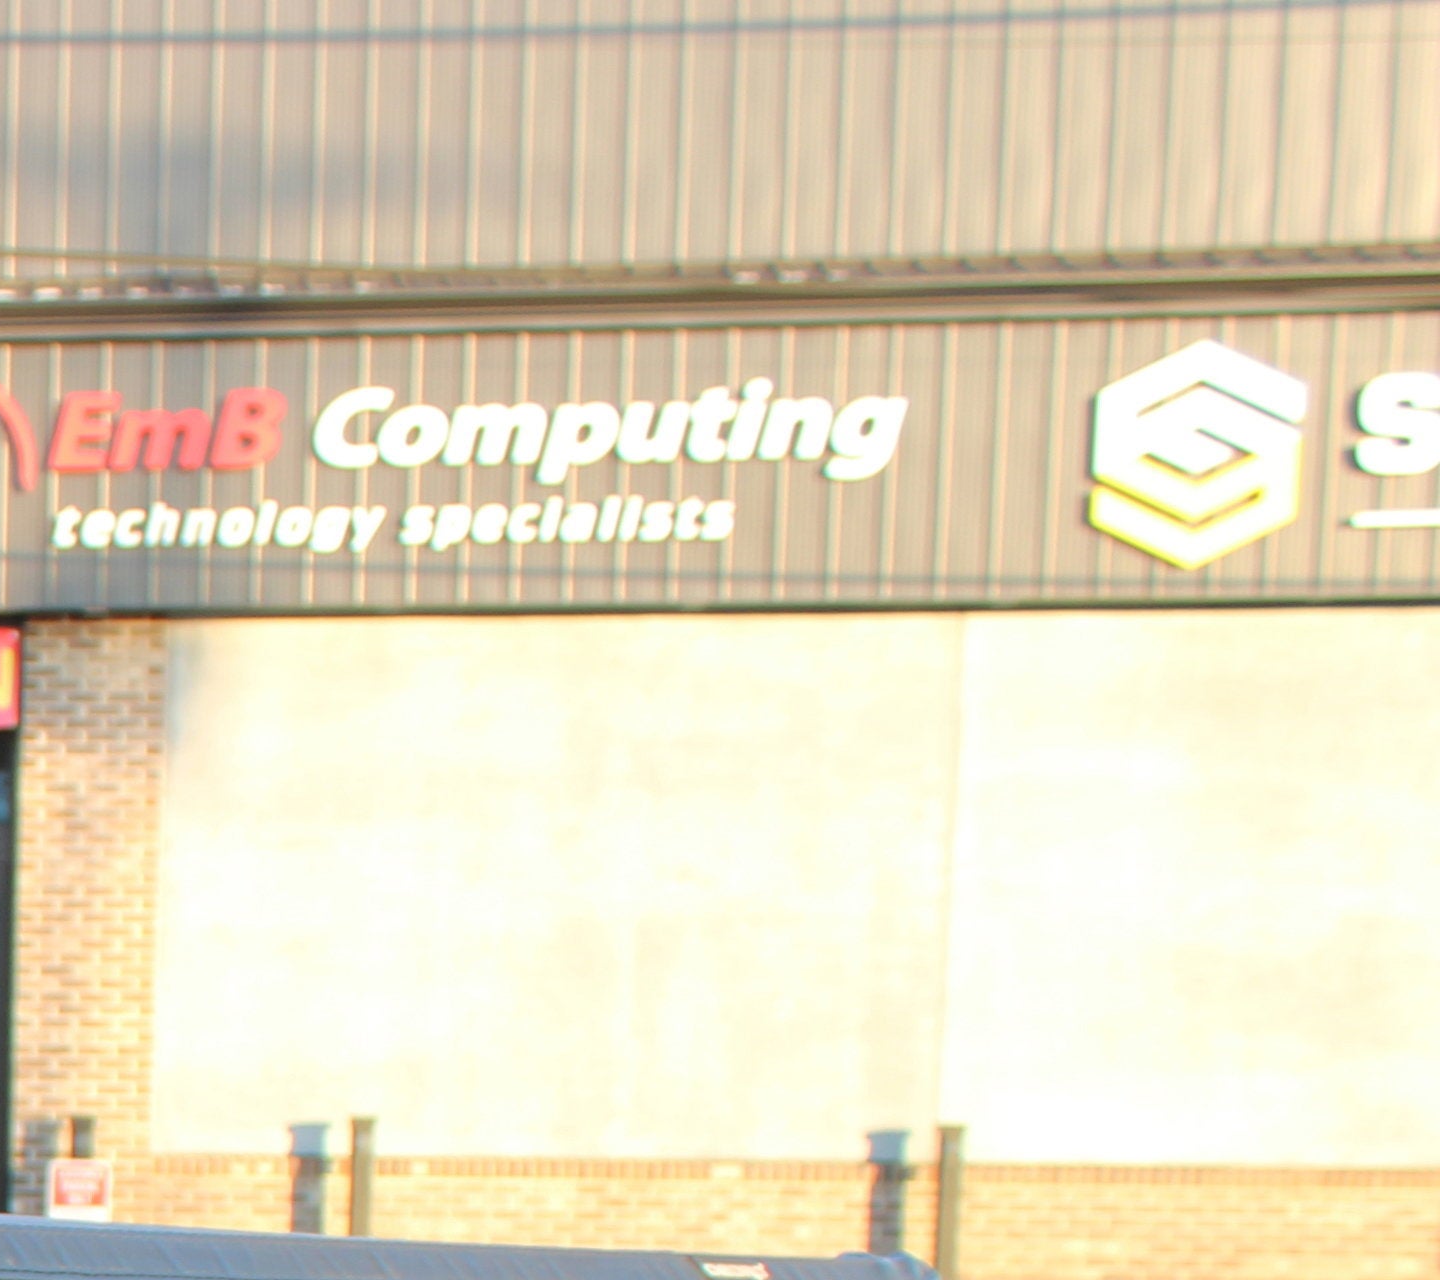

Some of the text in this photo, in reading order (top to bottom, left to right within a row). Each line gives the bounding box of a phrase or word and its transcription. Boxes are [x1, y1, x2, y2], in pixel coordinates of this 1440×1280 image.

[48, 377, 909, 485] EmB Computing
[51, 494, 736, 554] technology specialists
